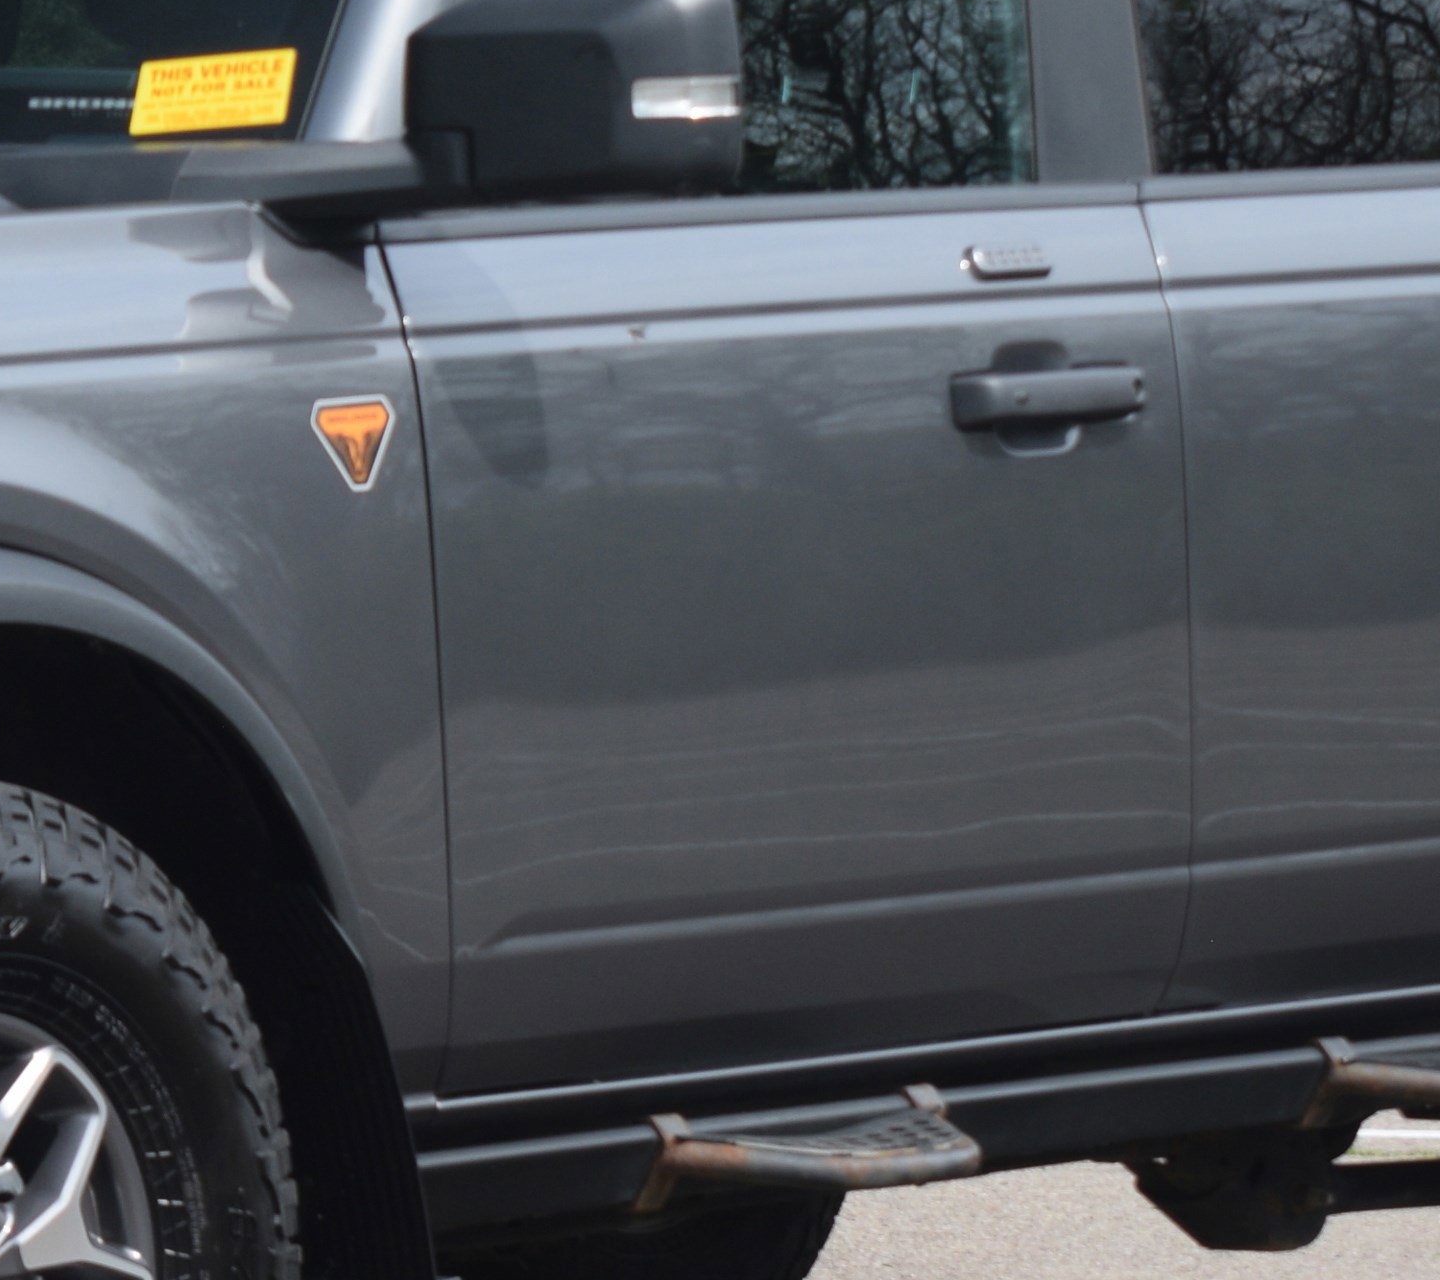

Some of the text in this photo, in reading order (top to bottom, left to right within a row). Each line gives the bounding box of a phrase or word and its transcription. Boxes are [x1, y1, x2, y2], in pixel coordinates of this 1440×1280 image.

[152, 57, 286, 82] THIS VEHICLE
[151, 77, 277, 98] NOT FOR SALE
[28, 97, 134, 110] BRON
